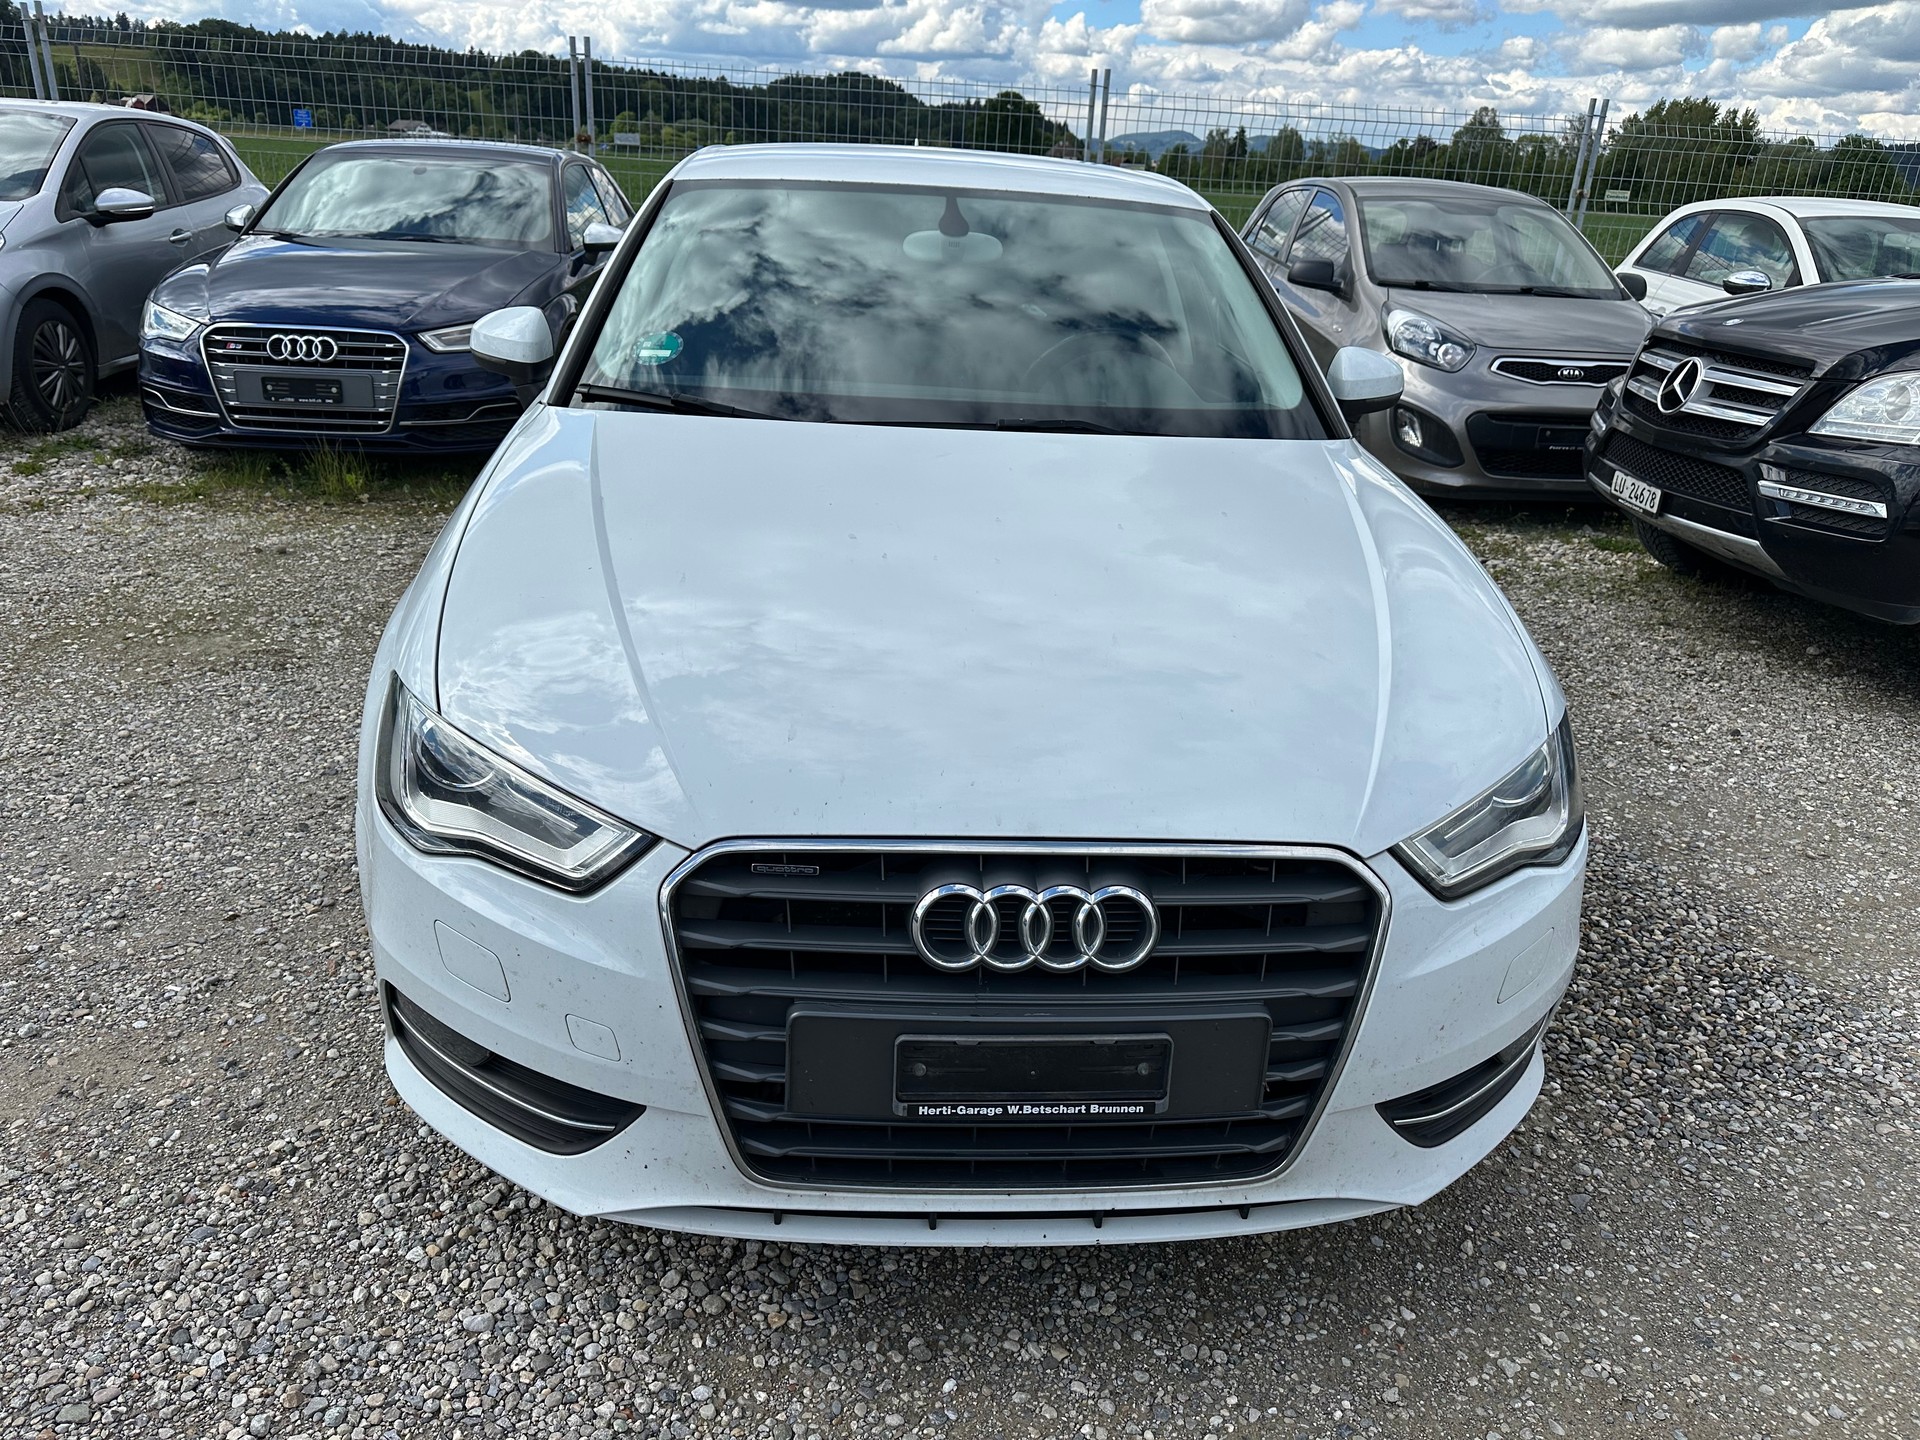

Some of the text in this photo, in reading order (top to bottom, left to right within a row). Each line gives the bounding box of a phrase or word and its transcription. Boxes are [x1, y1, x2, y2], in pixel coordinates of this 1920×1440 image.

[756, 865, 814, 873] quattro
[918, 1104, 1144, 1116] Herti-Garage W.Betschart Brunnen
